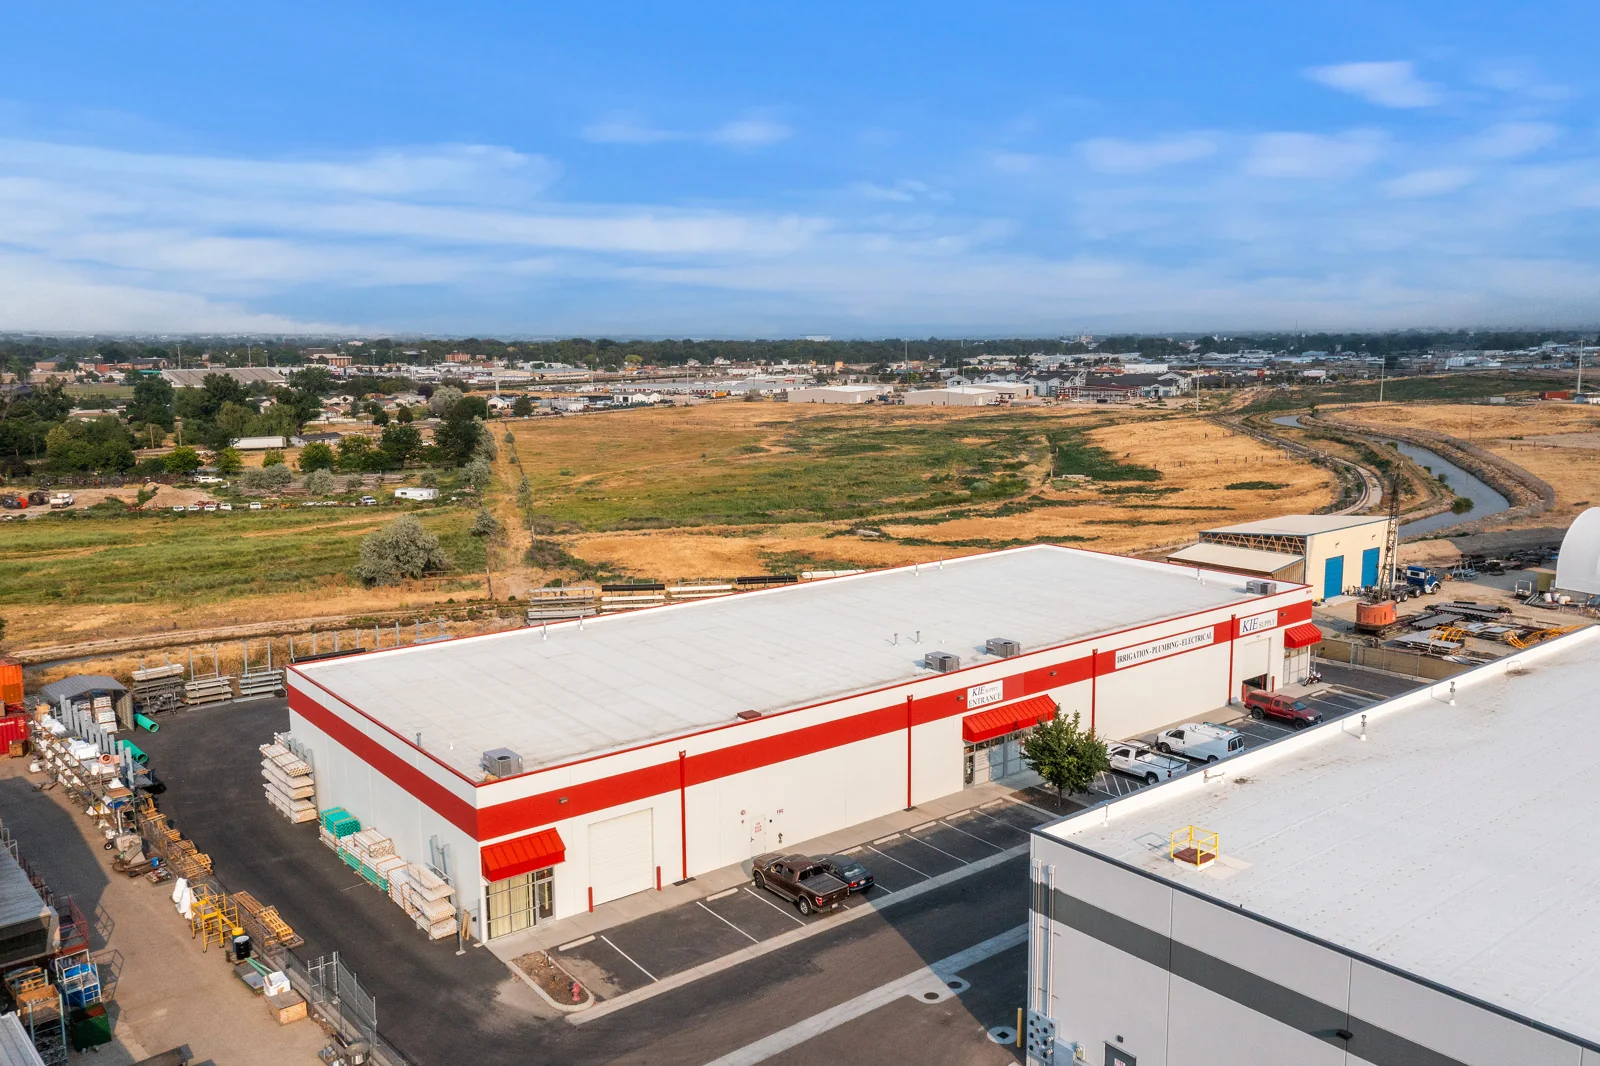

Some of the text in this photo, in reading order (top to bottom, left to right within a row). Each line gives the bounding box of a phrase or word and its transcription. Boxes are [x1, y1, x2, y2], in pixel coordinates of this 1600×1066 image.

[1242, 617, 1275, 633] KIE SUPPLY
[972, 685, 986, 697] KIE
[969, 692, 1001, 707] ENTRANCE
